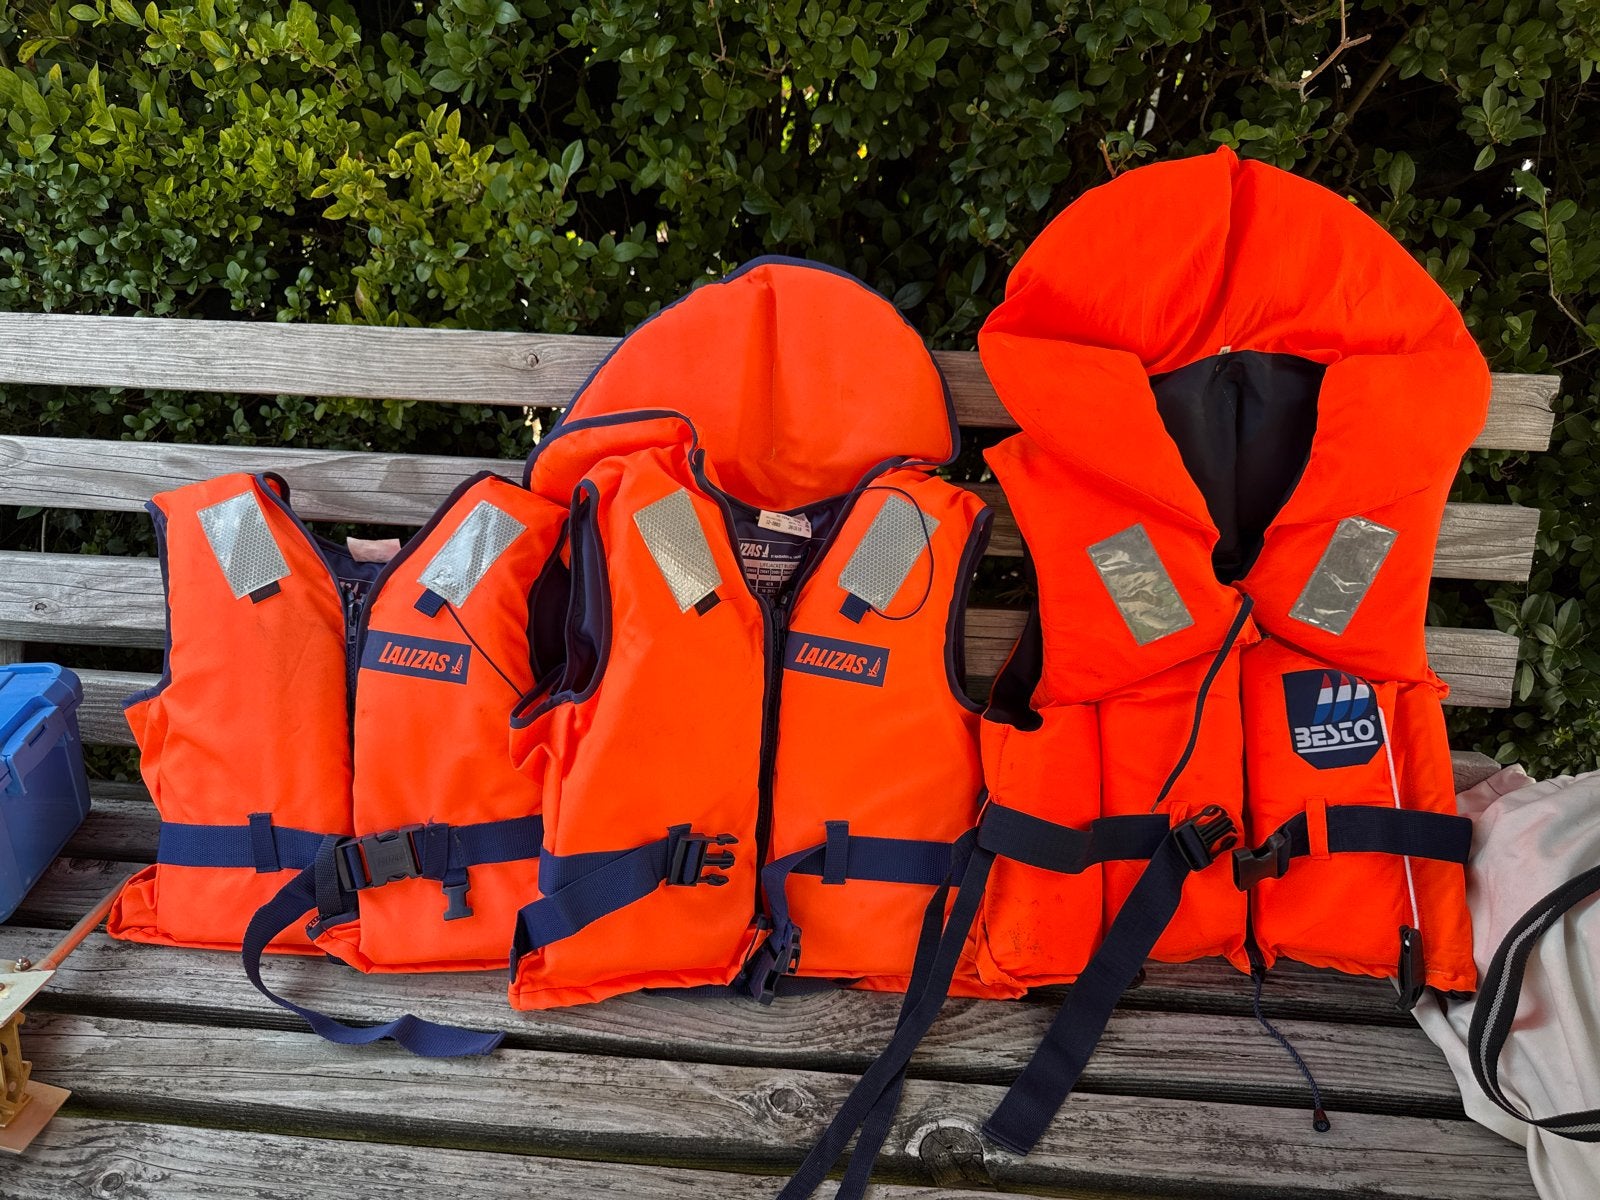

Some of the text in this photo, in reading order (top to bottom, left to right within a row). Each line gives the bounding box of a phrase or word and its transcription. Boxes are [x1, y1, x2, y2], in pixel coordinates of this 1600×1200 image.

[378, 641, 451, 672] LALIZAS
[795, 642, 868, 675] LALIZAS
[1294, 719, 1375, 748] BESTO
